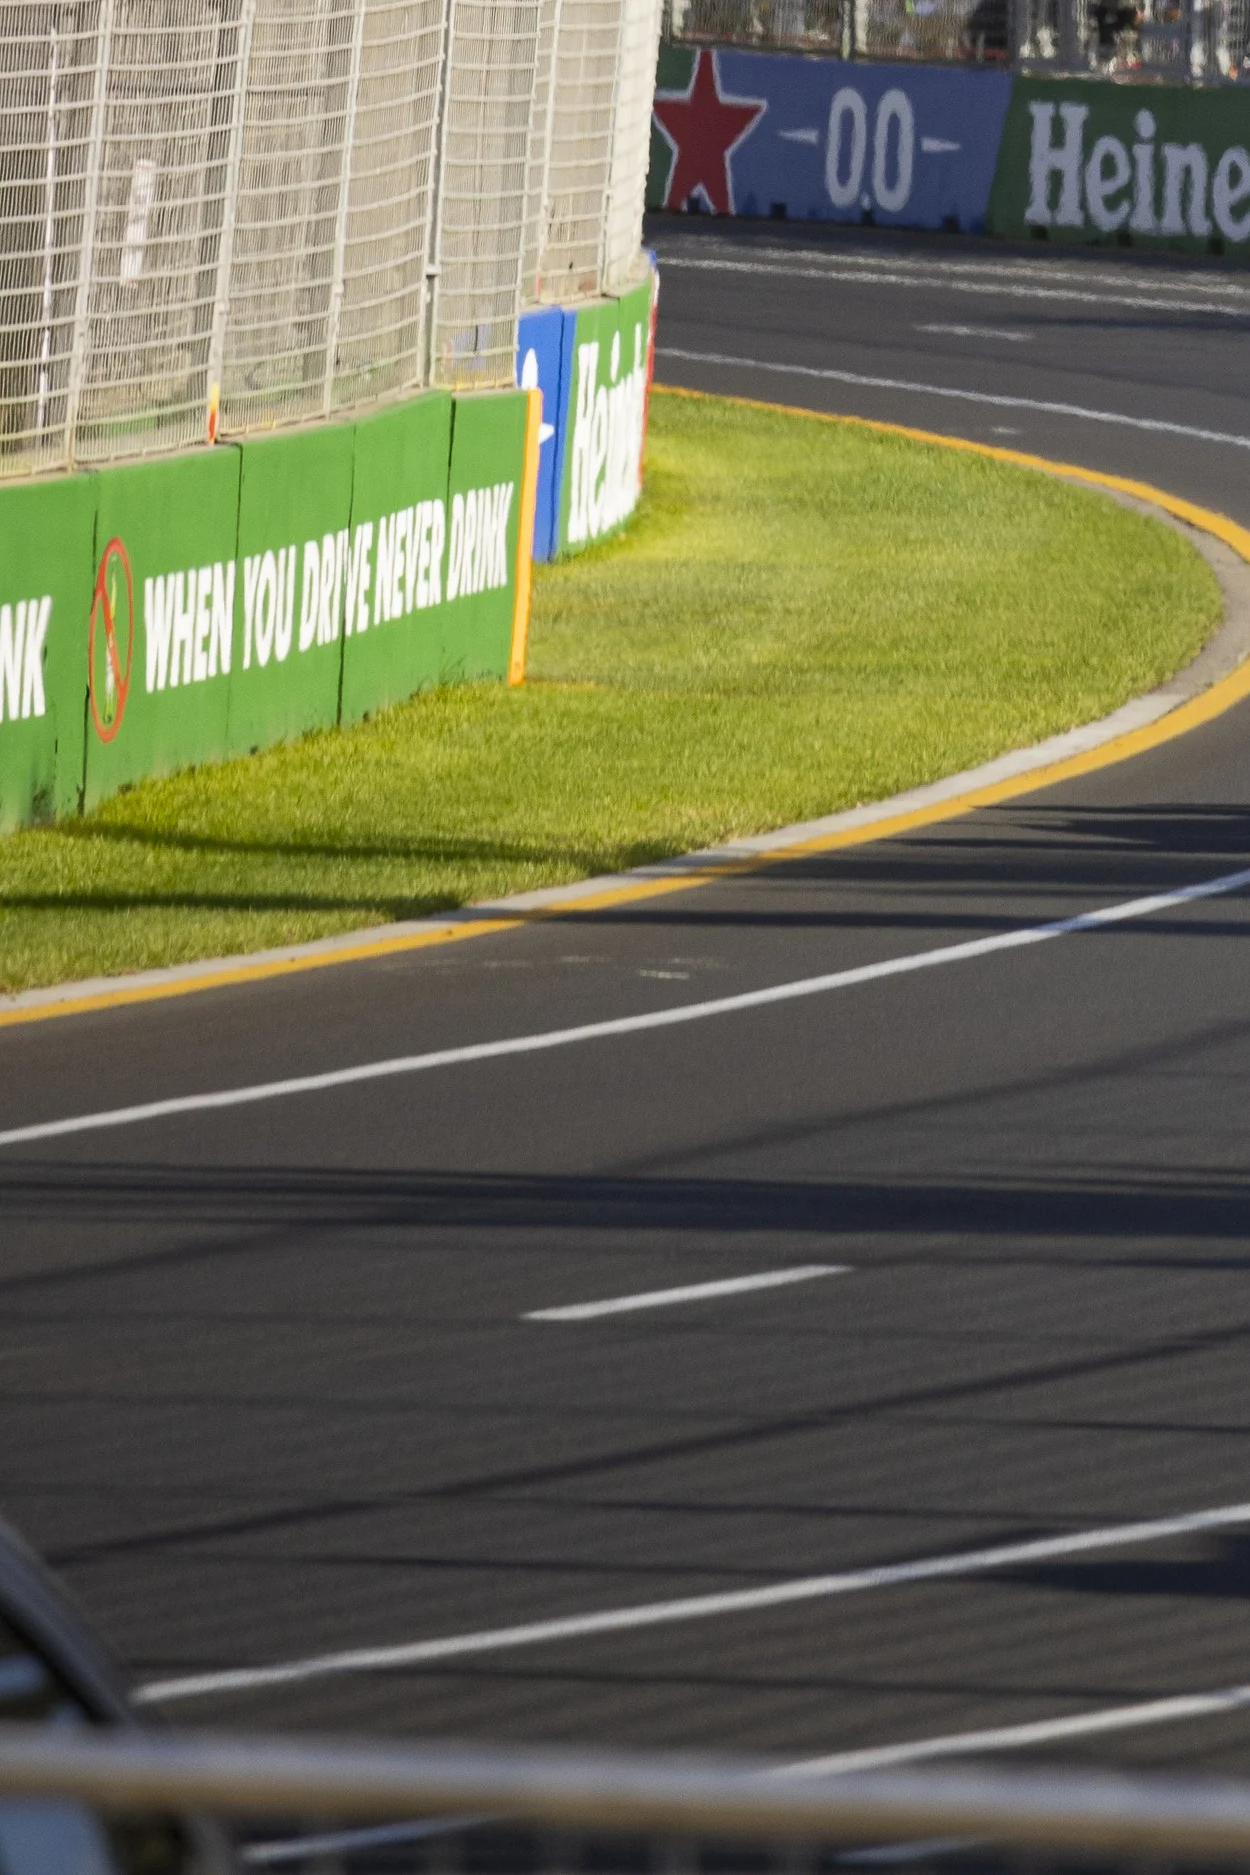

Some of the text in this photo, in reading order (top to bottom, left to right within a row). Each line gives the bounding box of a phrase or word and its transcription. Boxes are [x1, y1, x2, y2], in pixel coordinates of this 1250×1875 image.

[144, 481, 514, 693] WHEN YOU DRIVE NEVER DRINK
